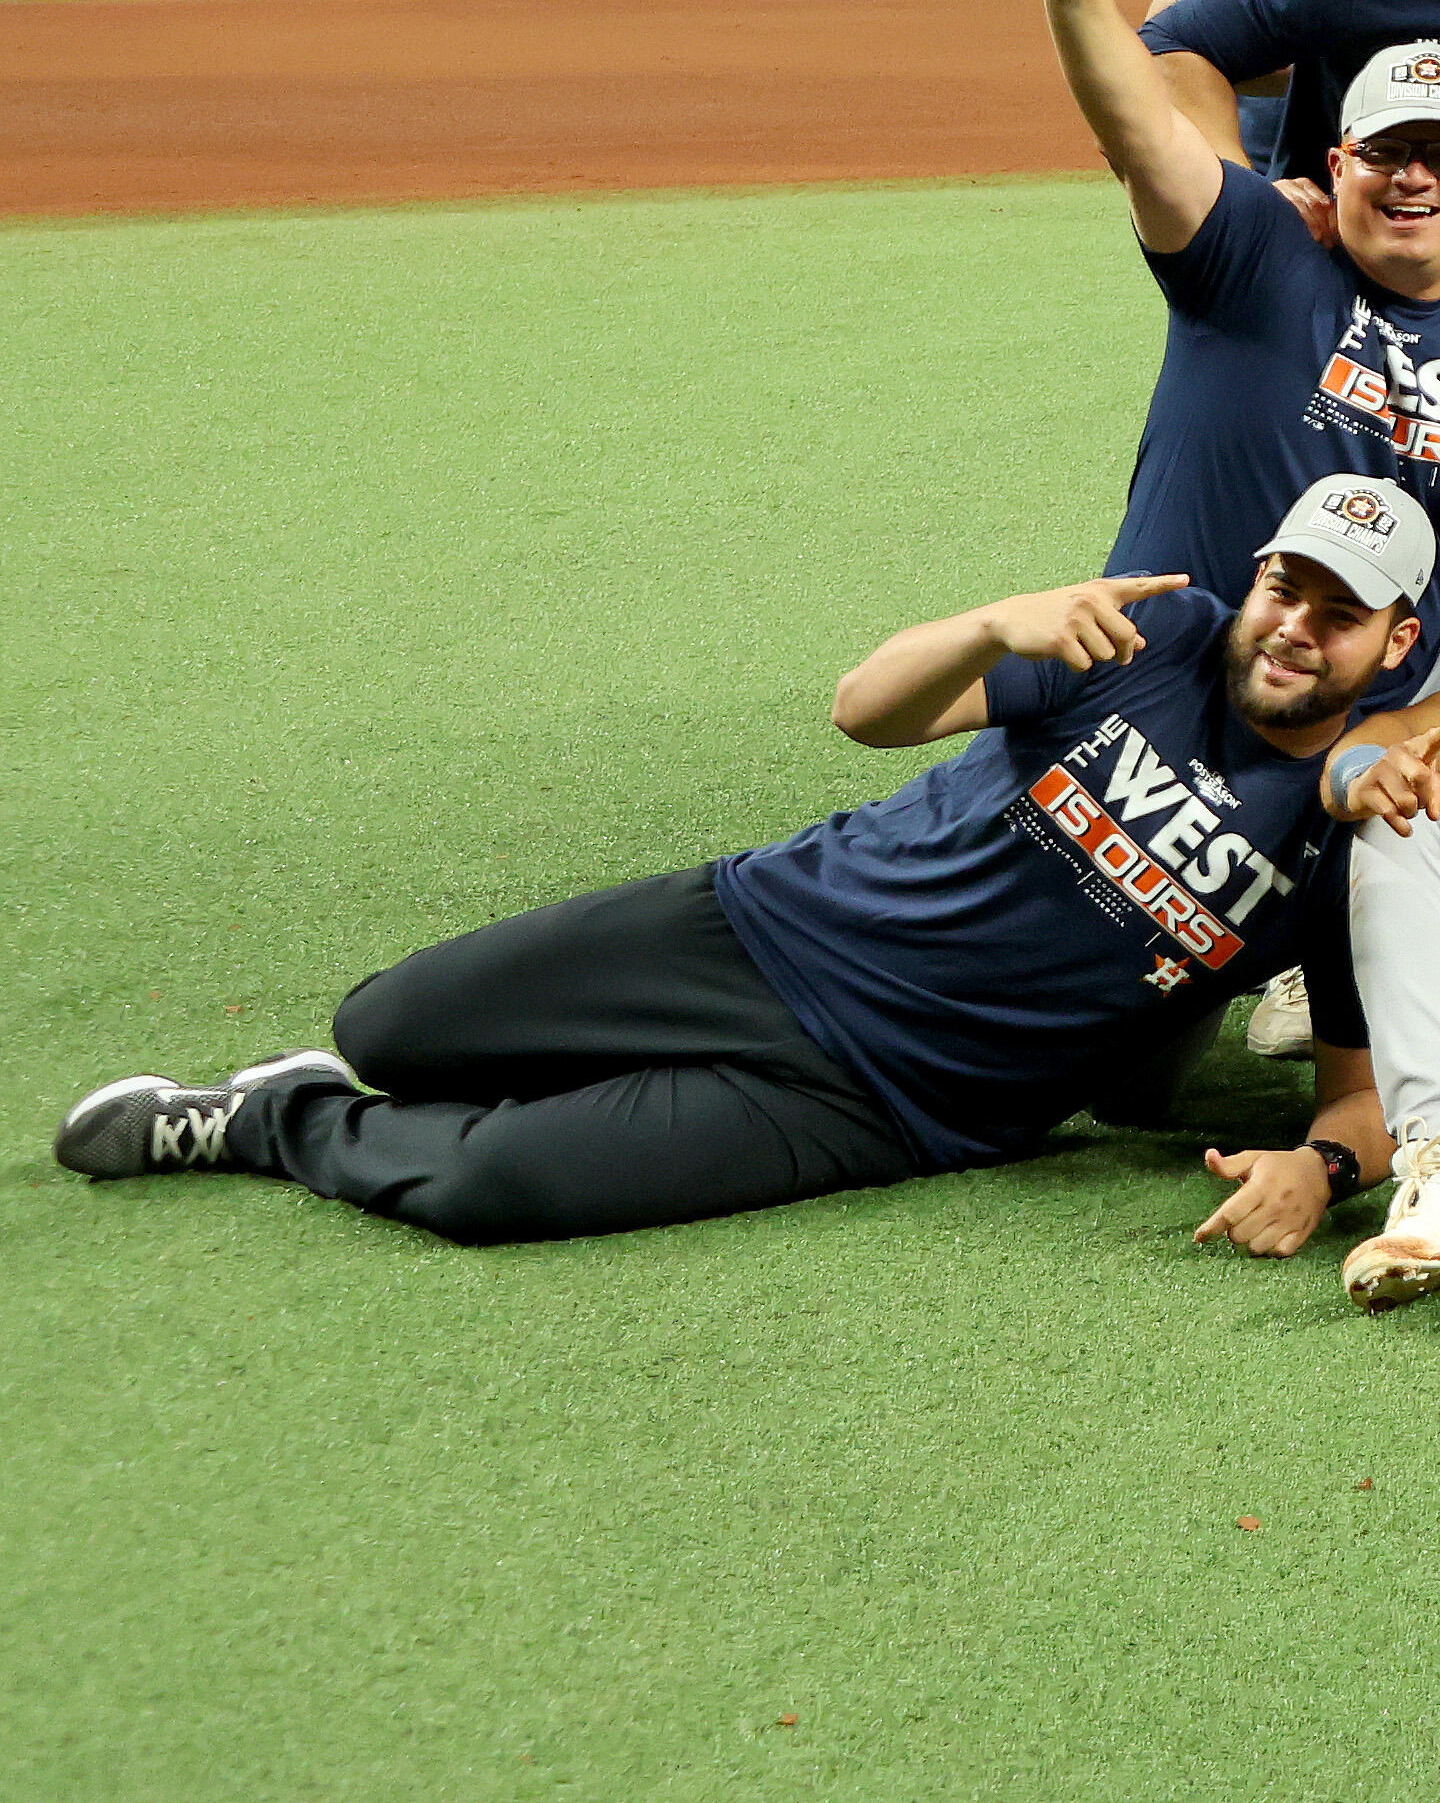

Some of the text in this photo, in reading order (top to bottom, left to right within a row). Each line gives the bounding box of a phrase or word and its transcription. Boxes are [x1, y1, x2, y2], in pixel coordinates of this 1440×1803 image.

[1064, 714, 1295, 927] THE WEST
[1190, 758, 1241, 809] POSTSEASON
[1047, 785, 1227, 954] IS OURS
